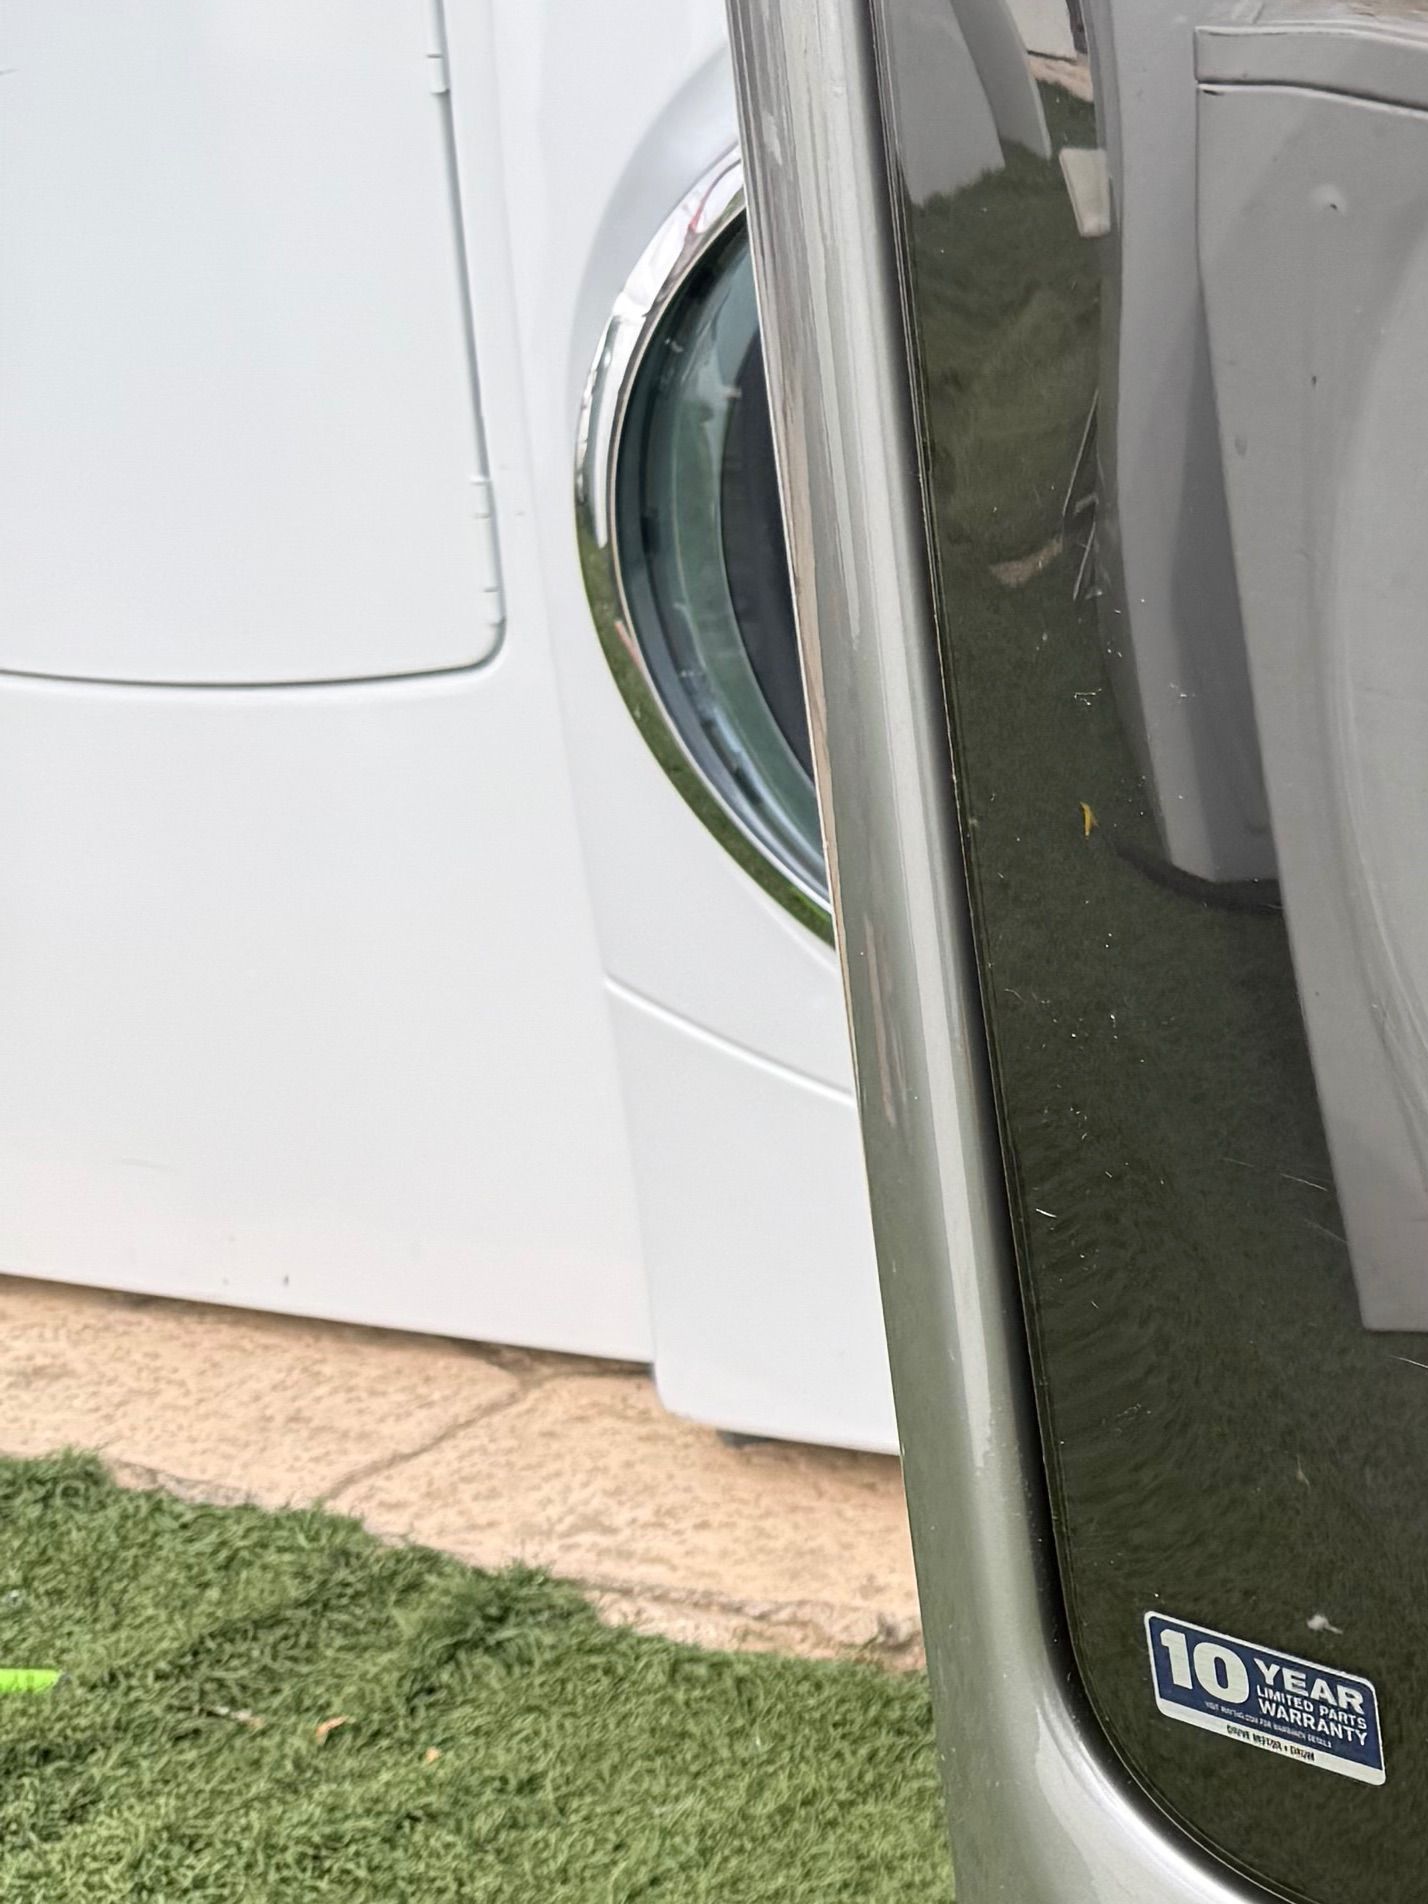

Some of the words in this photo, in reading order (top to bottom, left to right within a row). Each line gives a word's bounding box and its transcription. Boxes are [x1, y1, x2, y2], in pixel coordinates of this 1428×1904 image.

[1160, 1628, 1250, 1705] 10
[1254, 1657, 1365, 1715] YEAR
[1257, 1684, 1314, 1713] LIMITED
[1319, 1703, 1367, 1730] PARTS
[1257, 1697, 1368, 1747] WARRANTY
